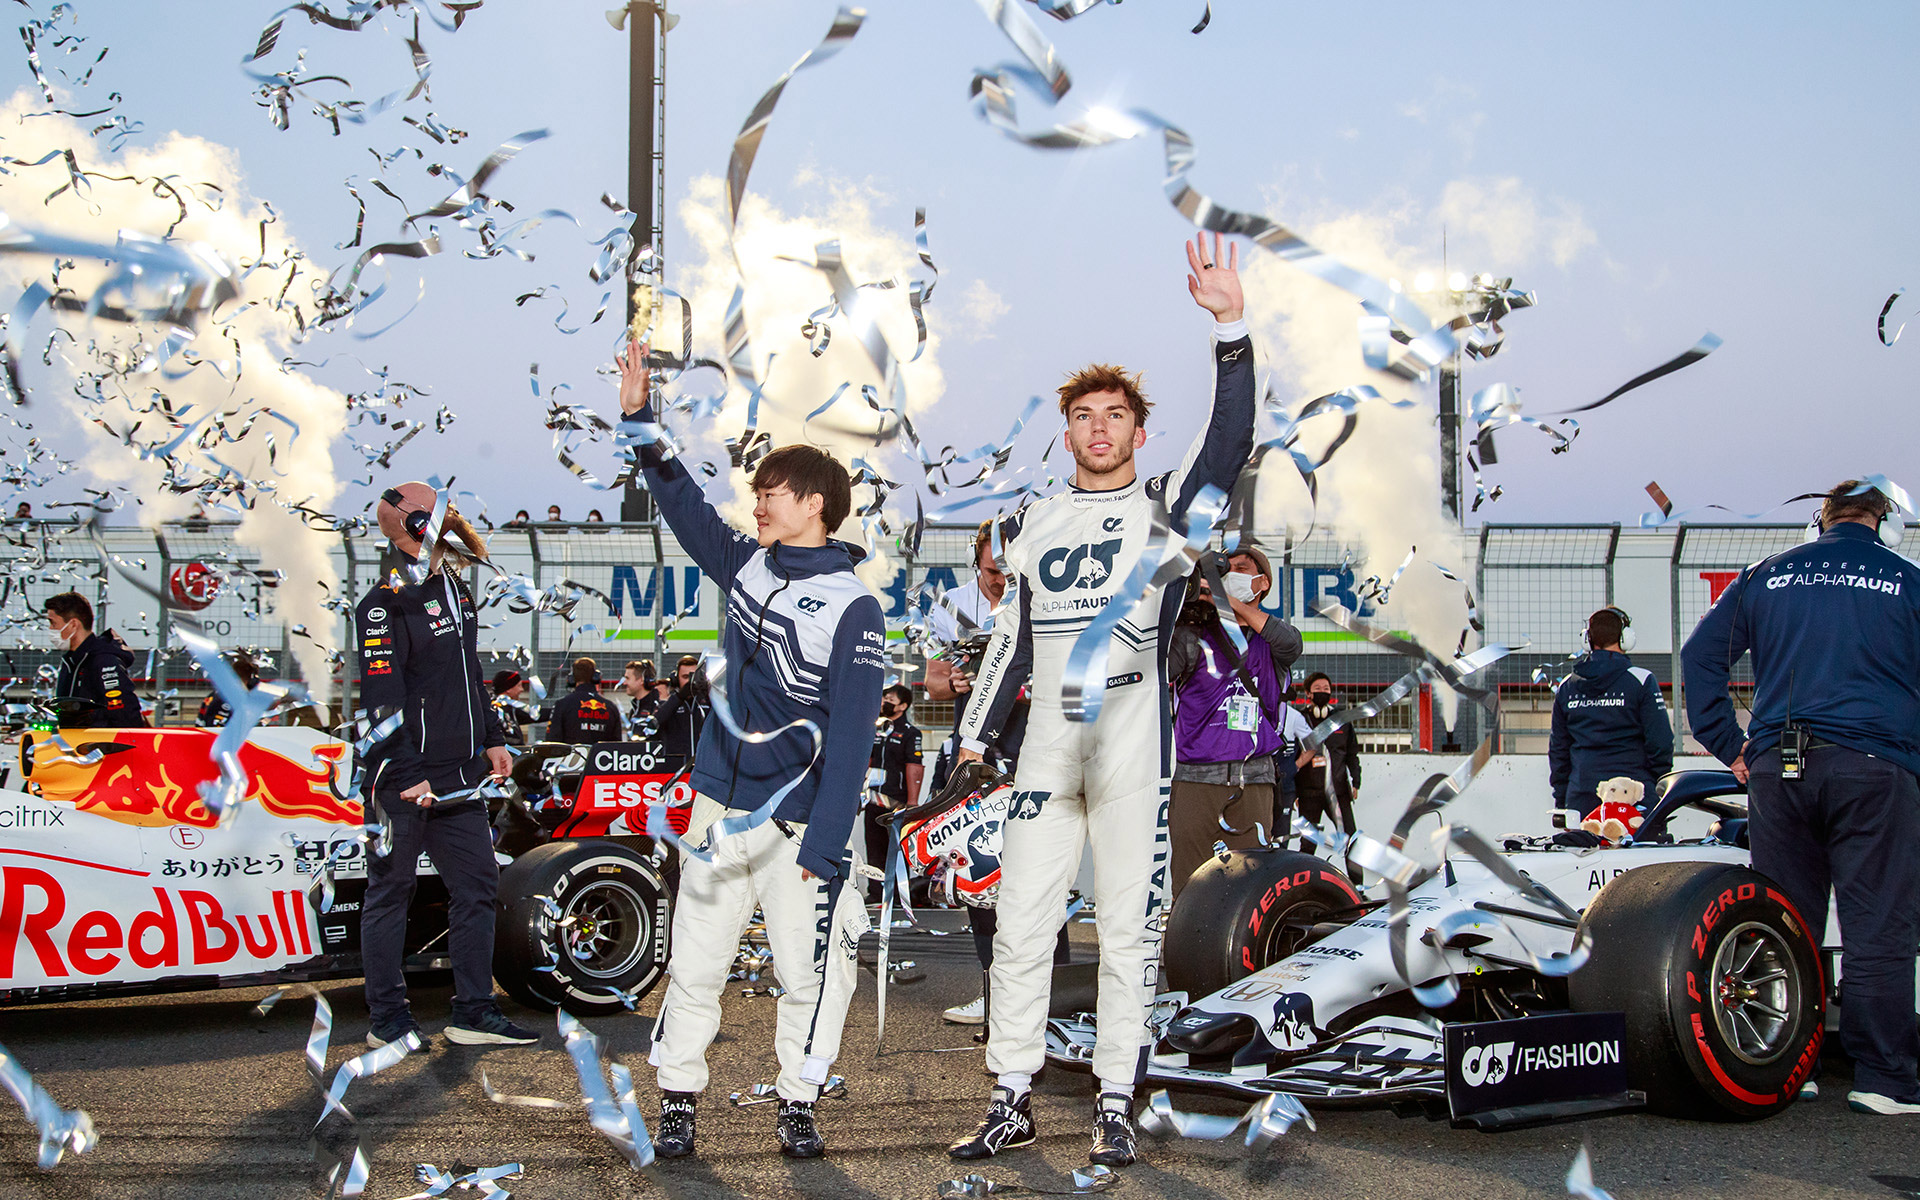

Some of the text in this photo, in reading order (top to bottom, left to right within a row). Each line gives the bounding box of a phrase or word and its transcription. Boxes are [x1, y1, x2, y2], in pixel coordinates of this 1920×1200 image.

[1769, 561, 1904, 579] SCUDERIA
[1793, 573, 1902, 597] ALPHATAURI
[365, 625, 386, 636] Claro
[433, 625, 456, 637] ORACLE
[863, 630, 884, 647] ICM
[1108, 675, 1129, 687] GASLY
[1578, 698, 1625, 708] ALPHATAURI
[594, 745, 660, 772] Claro
[593, 781, 693, 808] ESSO
[0, 804, 64, 828] citrix
[161, 853, 285, 878] ありがとう
[330, 902, 360, 913] EMENS
[1248, 869, 1311, 937] ZERO
[653, 898, 670, 964] PIRELLI
[1691, 882, 1756, 960] ZERO
[1782, 1021, 1824, 1099] PIRELLI
